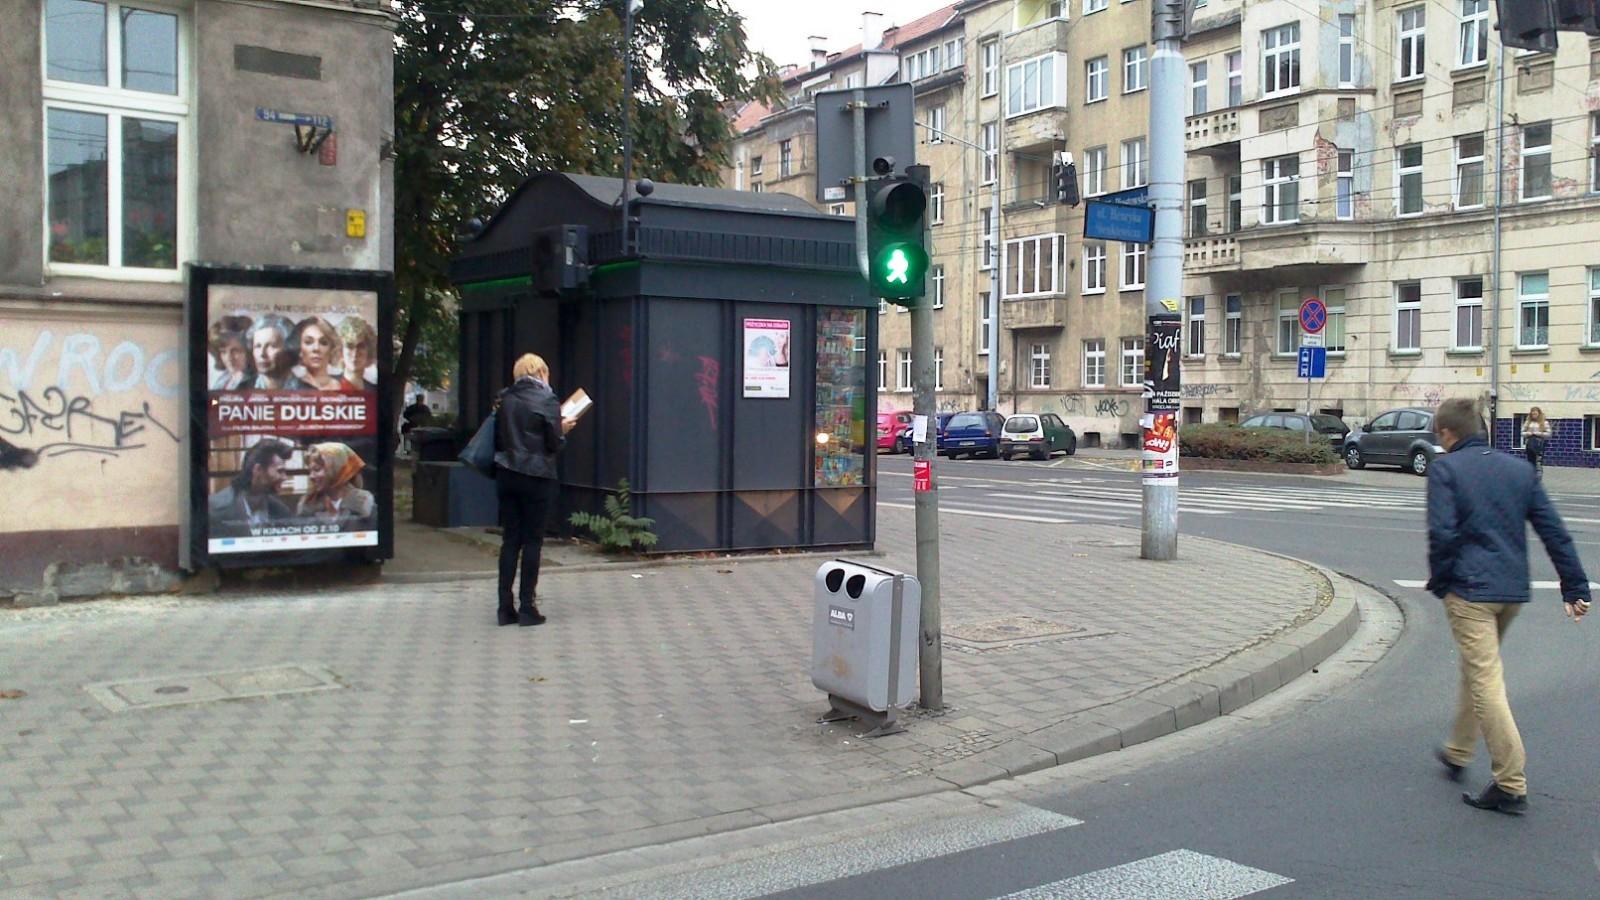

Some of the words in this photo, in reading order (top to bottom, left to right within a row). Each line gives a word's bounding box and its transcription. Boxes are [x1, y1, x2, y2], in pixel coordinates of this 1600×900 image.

[218, 405, 275, 421] PANIE
[281, 405, 367, 421] DULSKIE
[251, 528, 262, 536] W
[263, 526, 301, 535] KINACH
[303, 525, 319, 533] OD
[831, 609, 847, 621] ALBA
